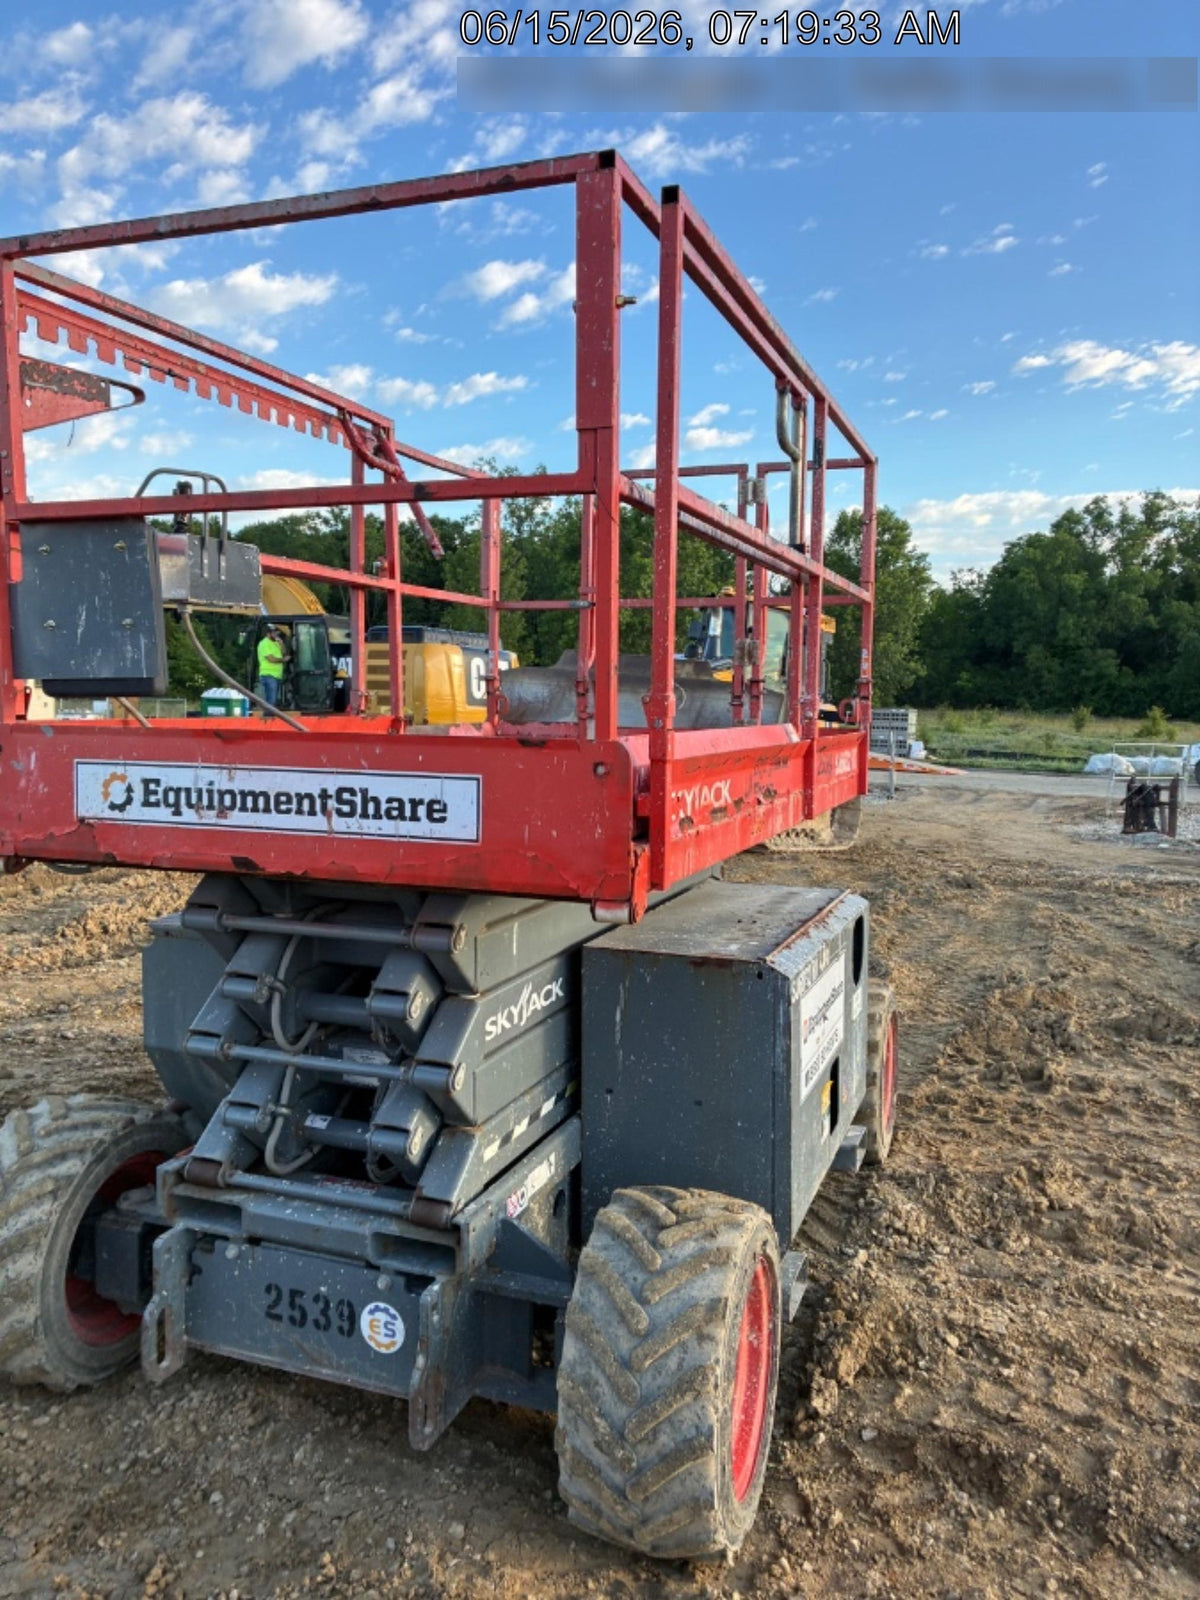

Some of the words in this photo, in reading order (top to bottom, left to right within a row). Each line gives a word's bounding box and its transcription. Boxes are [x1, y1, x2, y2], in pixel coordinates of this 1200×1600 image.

[140, 776, 448, 824] EquipmentShare
[484, 977, 565, 1041] SKYJACK
[264, 1282, 357, 1338] 2539
[369, 1318, 396, 1339] ES
